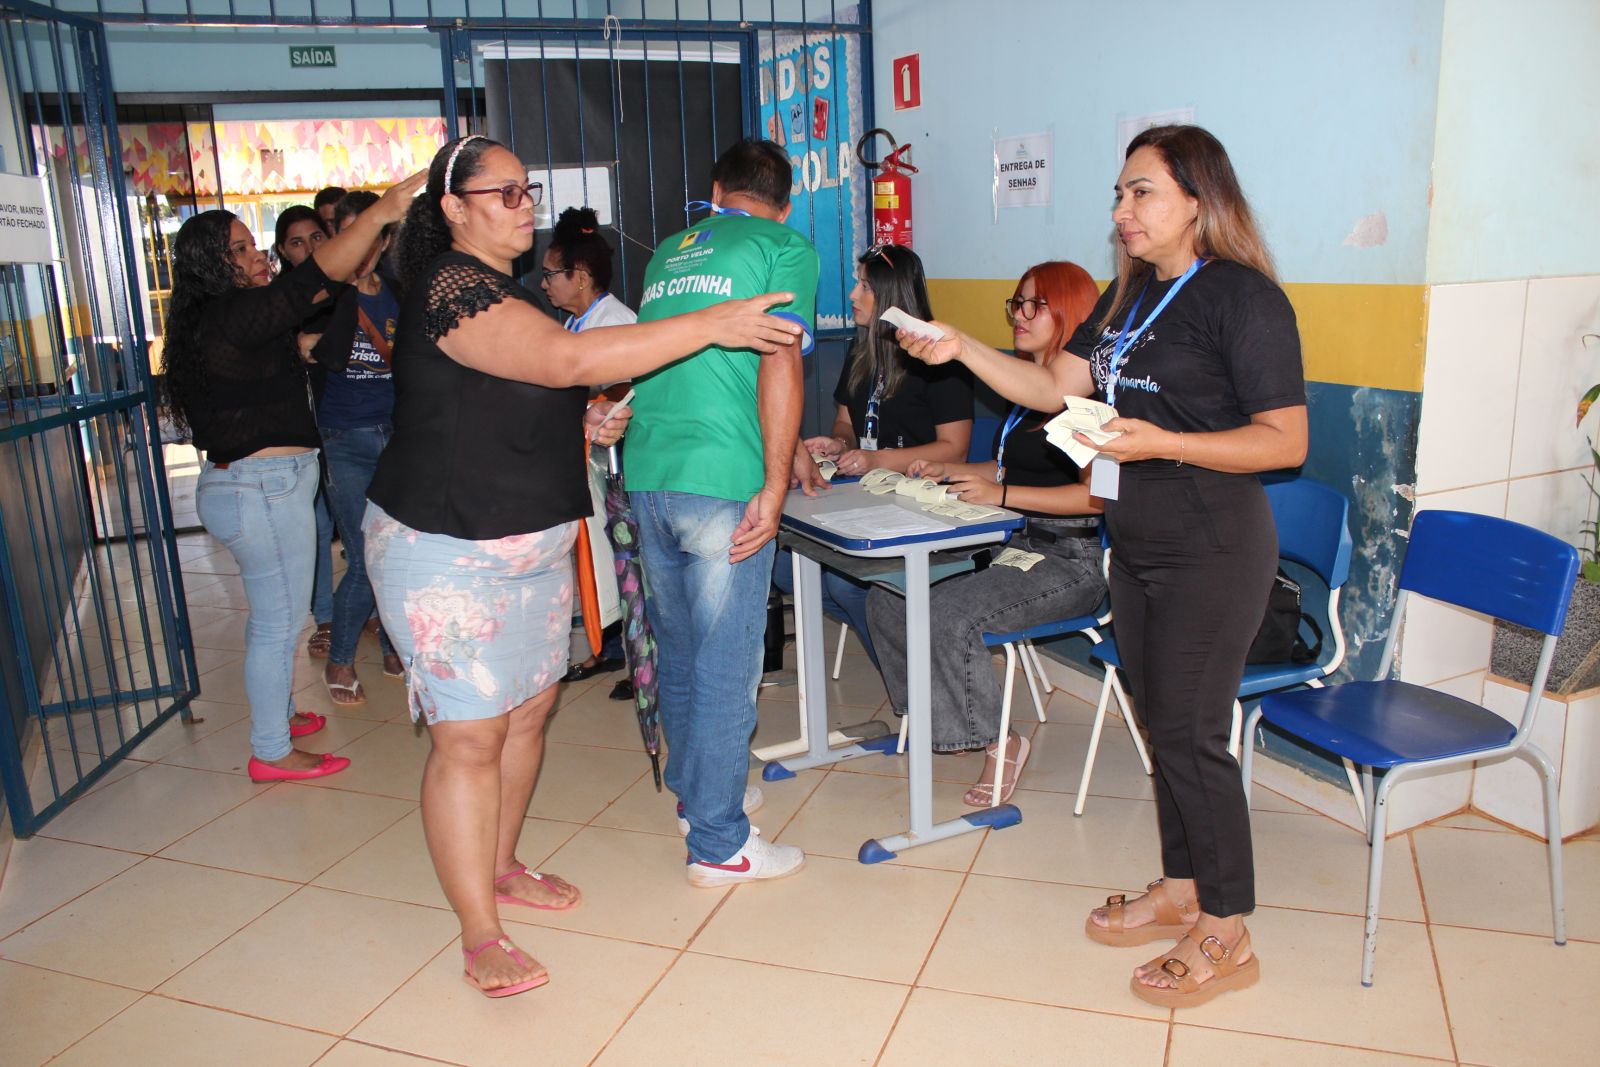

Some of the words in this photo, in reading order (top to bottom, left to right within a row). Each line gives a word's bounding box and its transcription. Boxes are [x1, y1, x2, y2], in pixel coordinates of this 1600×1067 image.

[292, 48, 334, 64] SAÍDA
[1000, 161, 1033, 173] ENTREGA
[1035, 159, 1046, 169] DE
[1008, 177, 1037, 188] SENHAS
[20, 206, 44, 215] MANTER
[665, 254, 690, 264] PORTO
[667, 274, 732, 297] COTINHA
